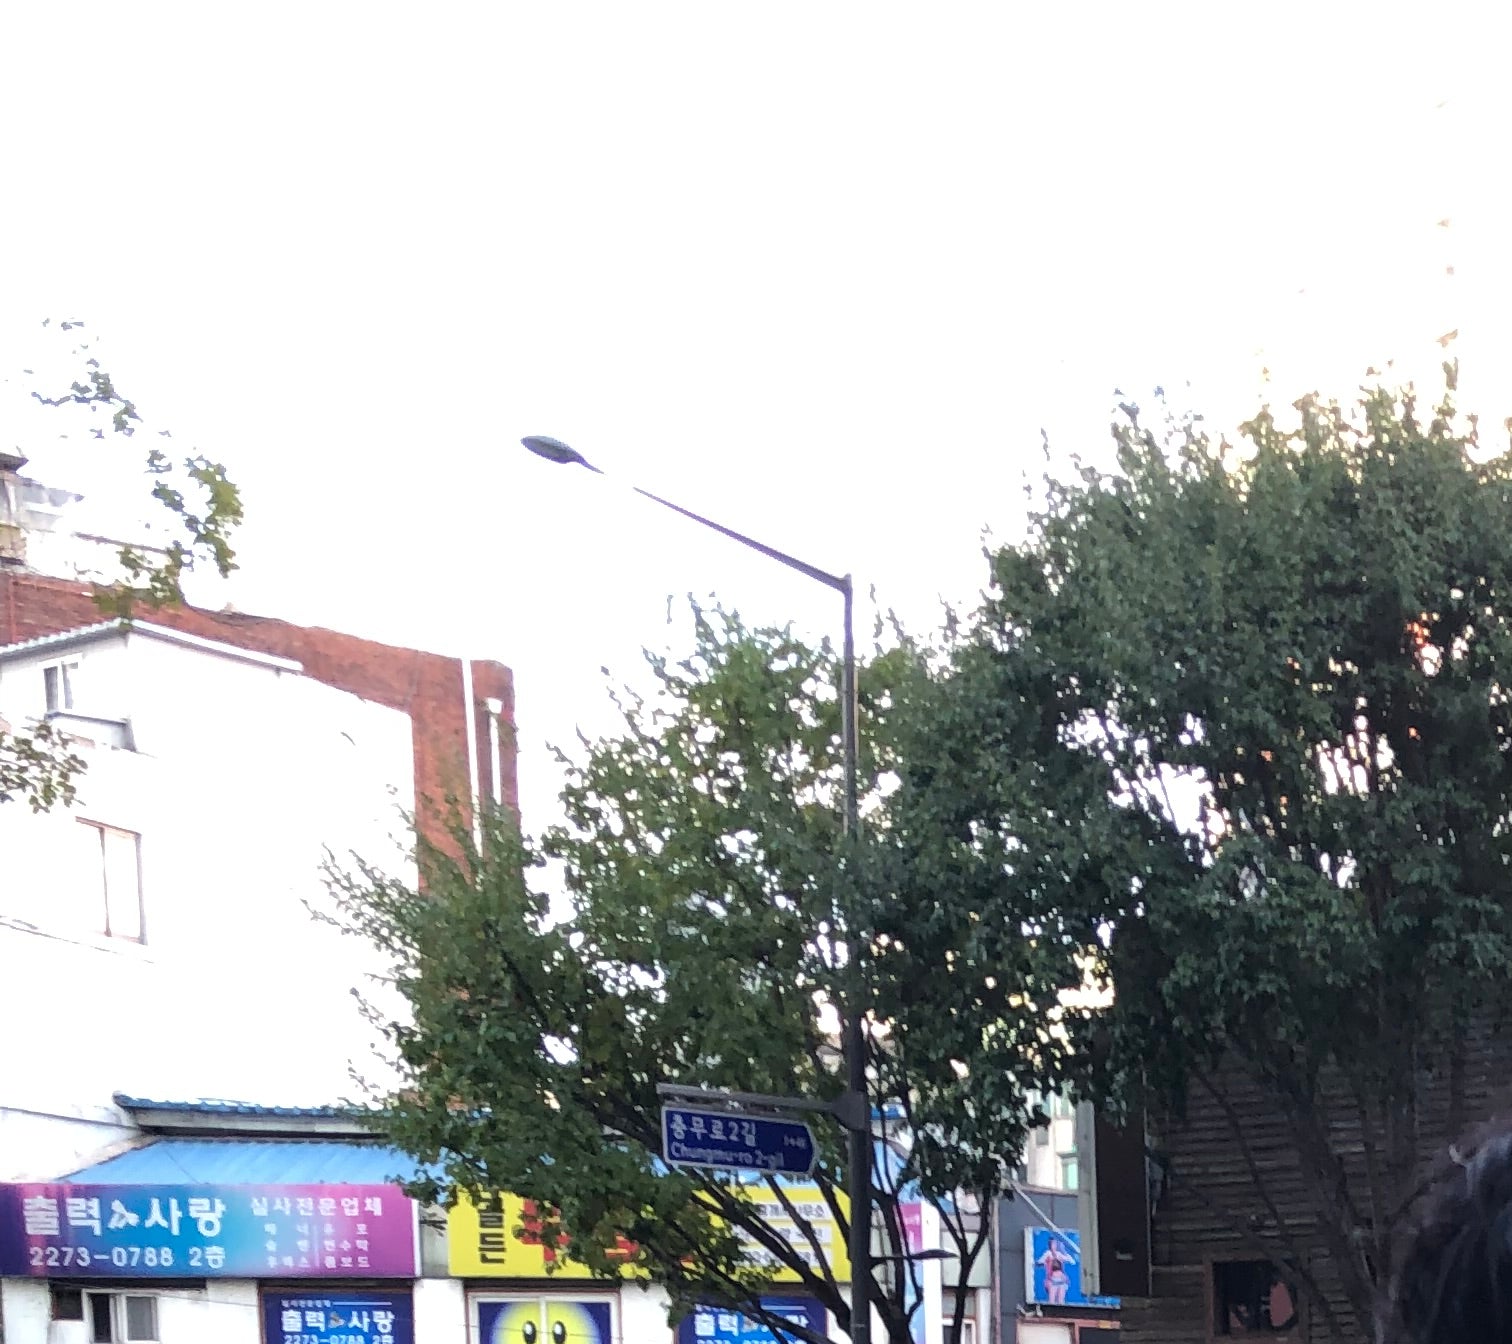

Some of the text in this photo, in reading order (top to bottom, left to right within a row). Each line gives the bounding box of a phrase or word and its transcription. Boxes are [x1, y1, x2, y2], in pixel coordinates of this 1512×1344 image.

[669, 1113, 757, 1147] 충무로2길
[23, 1195, 226, 1237] 출력 사랑
[29, 1245, 226, 1268] 2273-0788 2층
[281, 1310, 395, 1333] 출력 사랑
